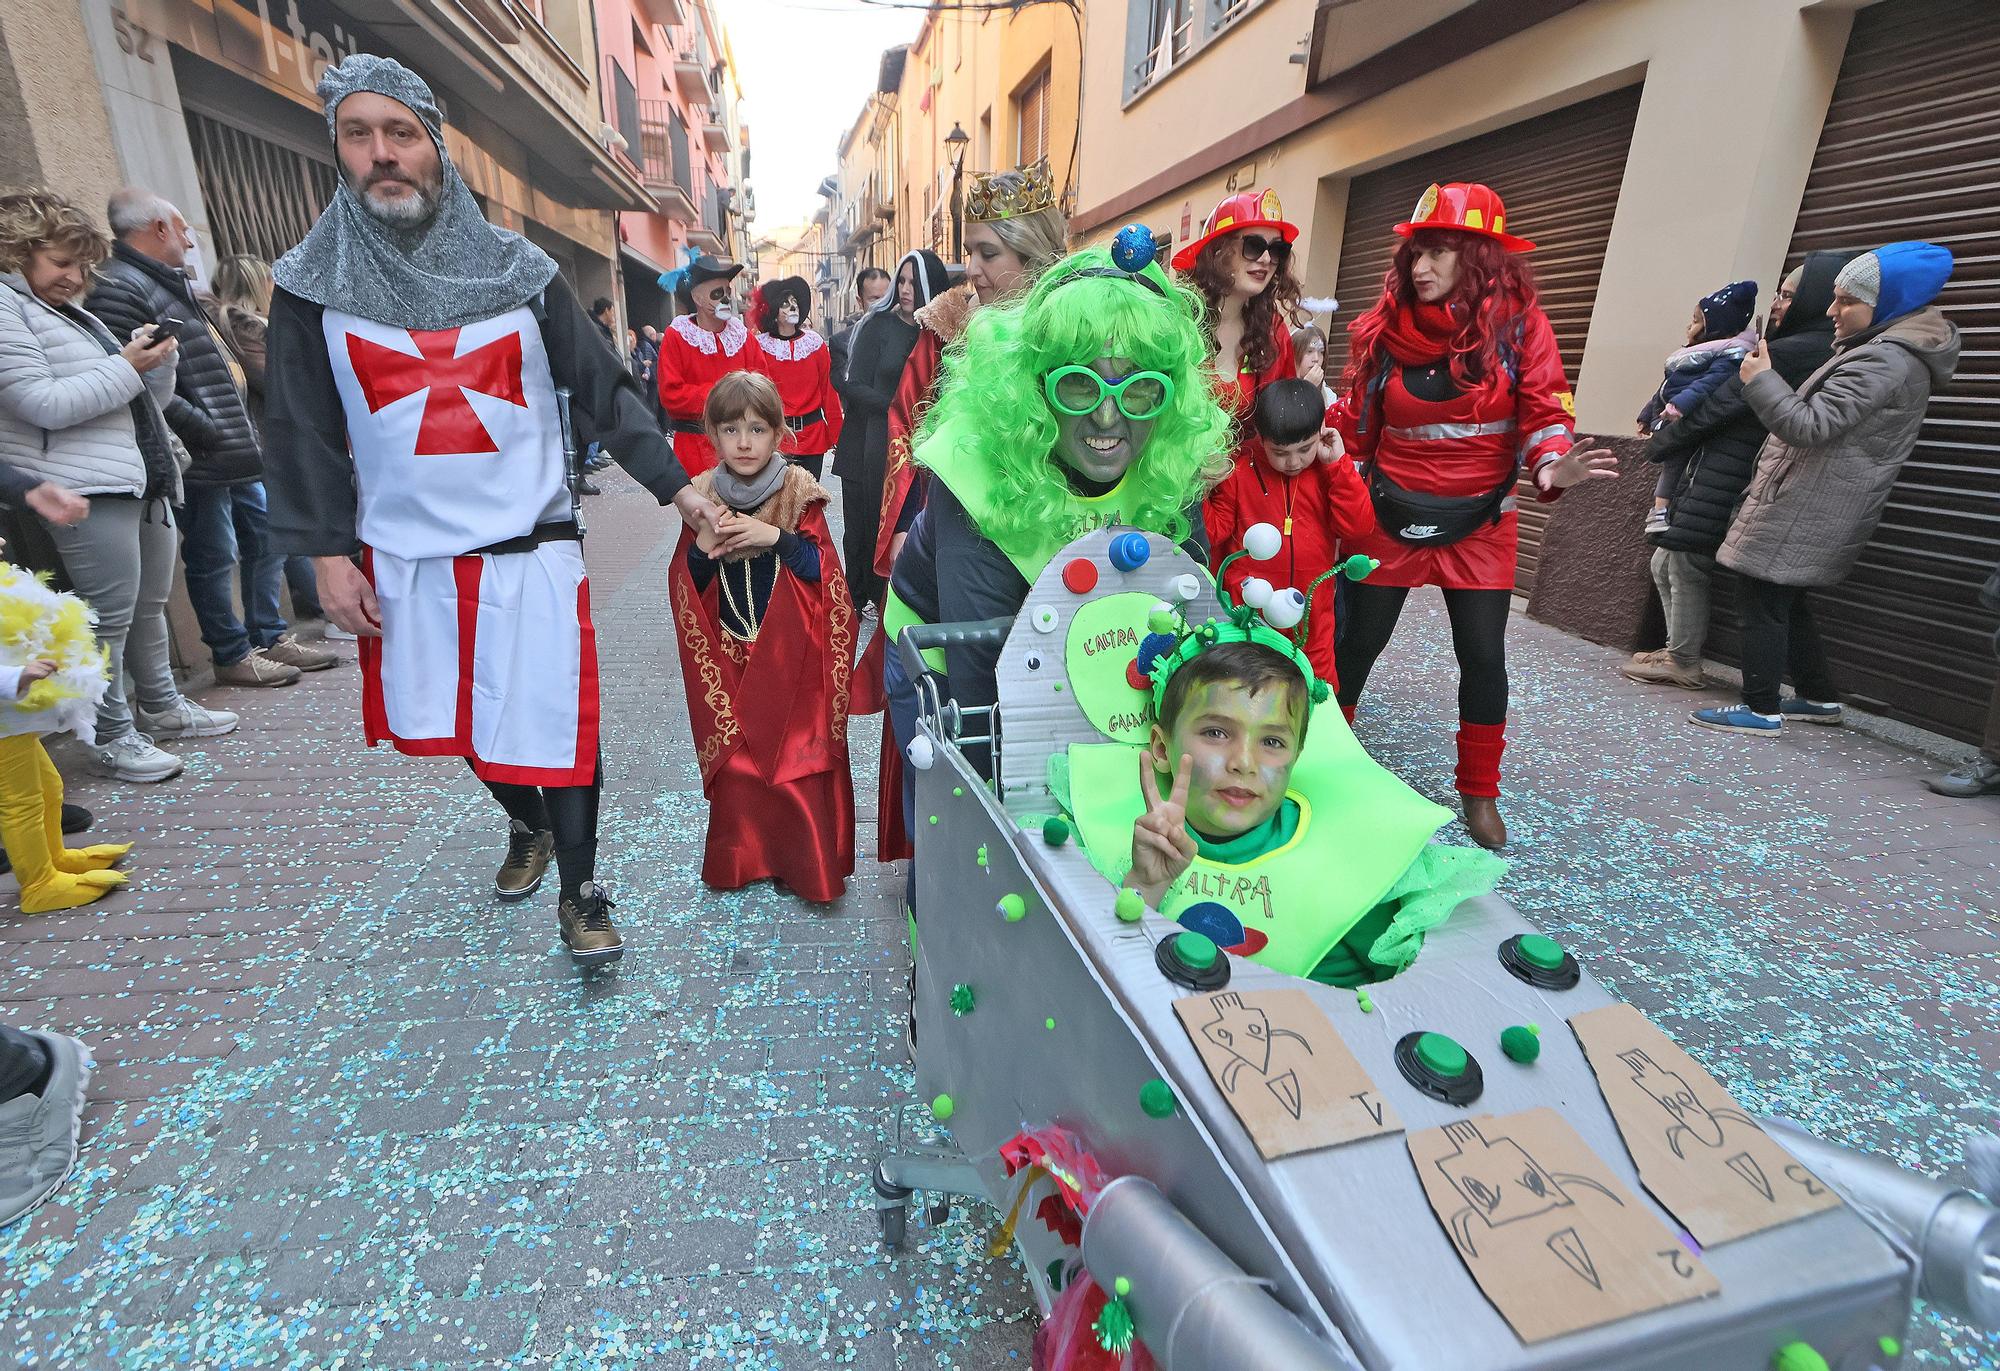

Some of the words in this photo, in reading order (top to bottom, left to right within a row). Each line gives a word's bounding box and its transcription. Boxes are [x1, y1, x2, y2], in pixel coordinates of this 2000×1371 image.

[111, 6, 155, 65] 52
[1226, 173, 1237, 192] 45
[1083, 626, 1139, 656] L'ALTRA
[1784, 1164, 1826, 1196] 3
[1656, 1249, 1694, 1279] 2
